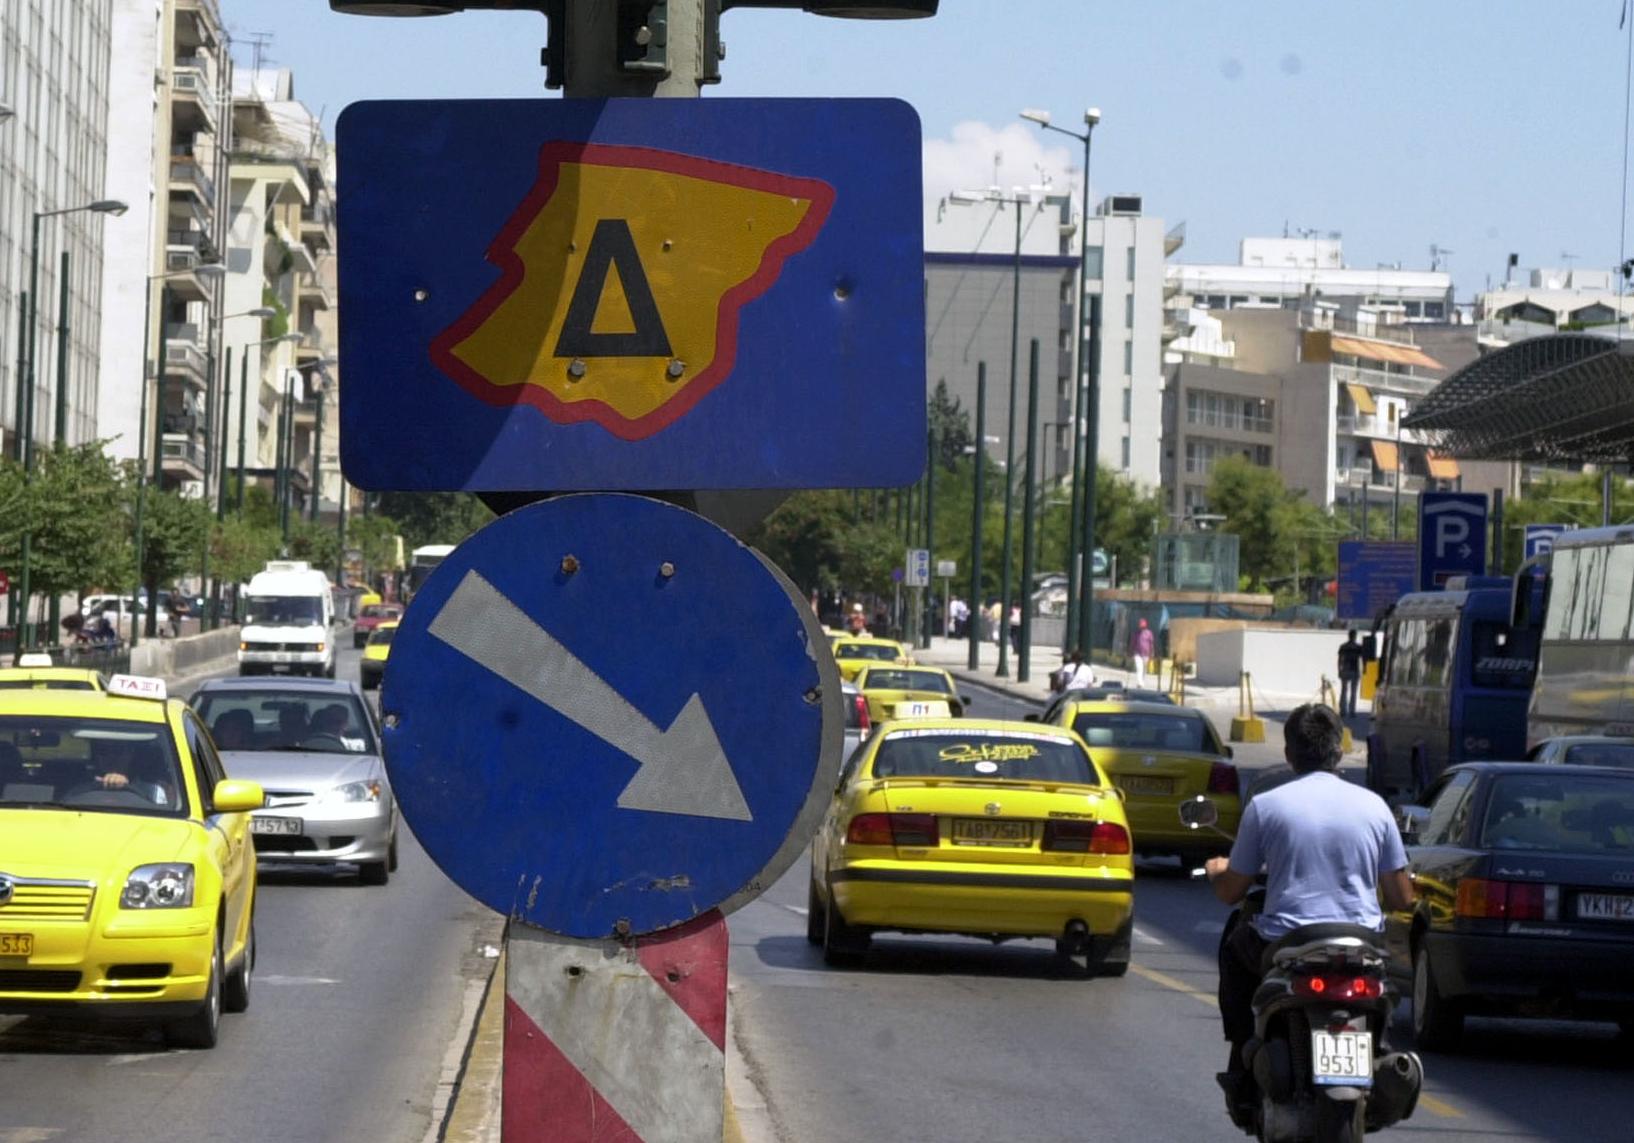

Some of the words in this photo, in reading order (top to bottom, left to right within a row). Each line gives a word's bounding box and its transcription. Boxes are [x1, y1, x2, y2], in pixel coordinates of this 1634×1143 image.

[554, 219, 673, 357] Δ
[1437, 516, 1469, 558] P
[1320, 1055, 1354, 1075] 953
